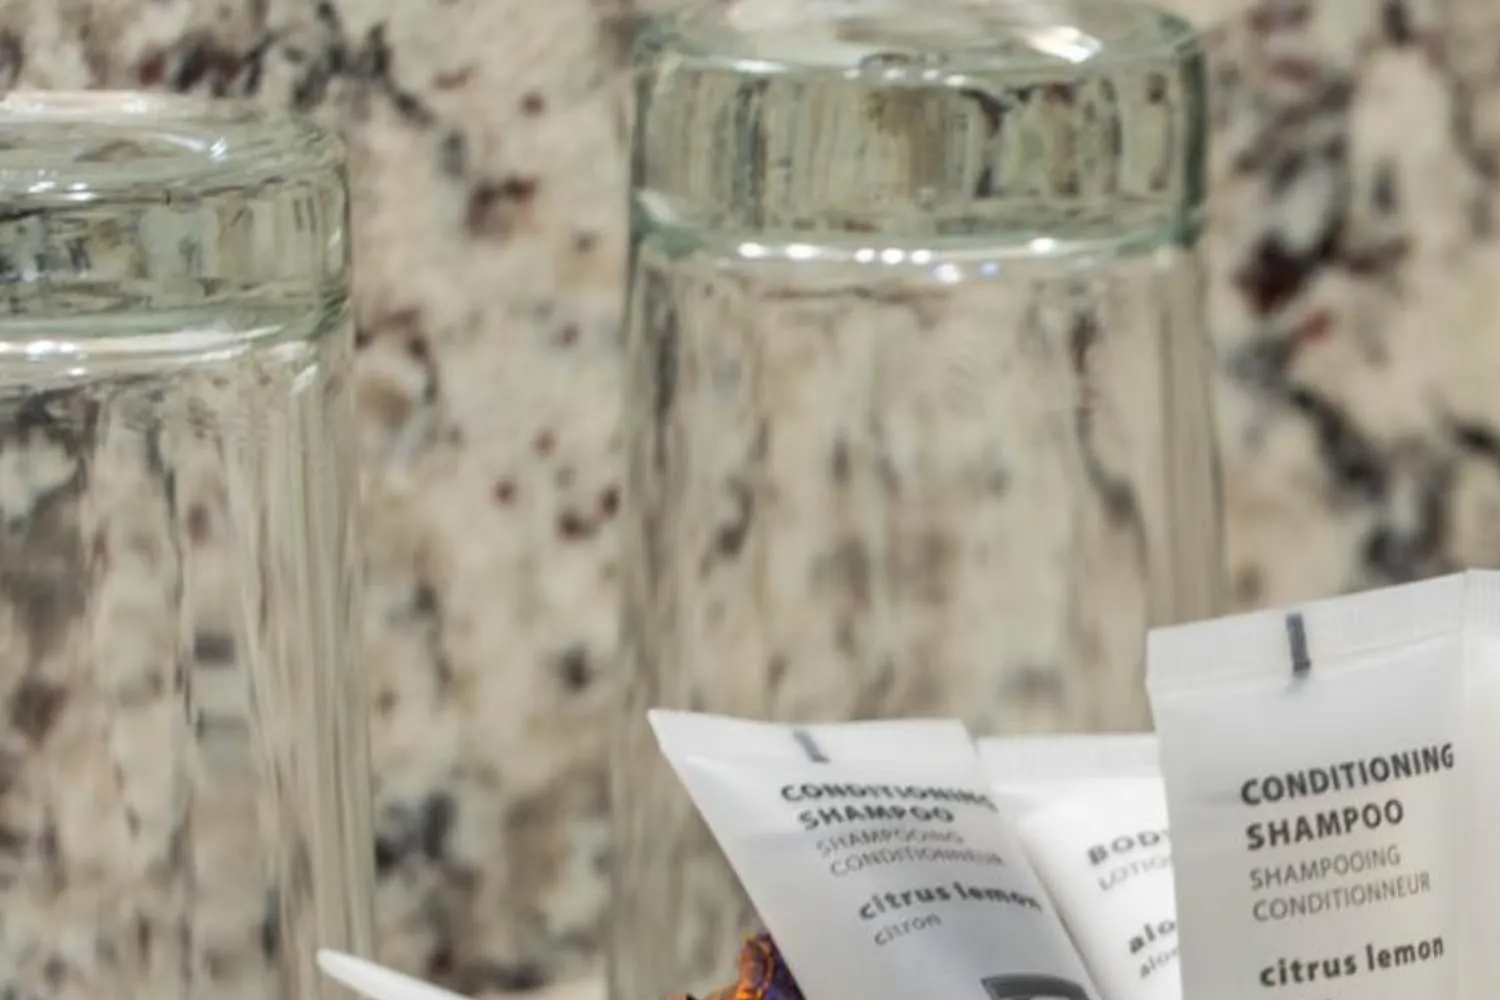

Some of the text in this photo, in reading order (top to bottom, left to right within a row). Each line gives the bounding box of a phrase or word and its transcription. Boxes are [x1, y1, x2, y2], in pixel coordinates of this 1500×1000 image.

[1240, 742, 1456, 806] CONDITIONING
[780, 783, 999, 812] CONDITIONING
[799, 804, 956, 832] SHAMPOO
[1246, 798, 1405, 851] SHAMPOO
[1087, 829, 1168, 867] BOD
[1097, 855, 1169, 892] LOTIO
[1249, 844, 1402, 891] SHAMPOOING
[859, 881, 1043, 922] citrus lemon
[1252, 871, 1432, 923] CONDITIONNEUR
[872, 913, 943, 946] citron
[1129, 920, 1176, 955] alo
[1140, 949, 1178, 979] alo
[1259, 935, 1444, 989] citrus lemon
